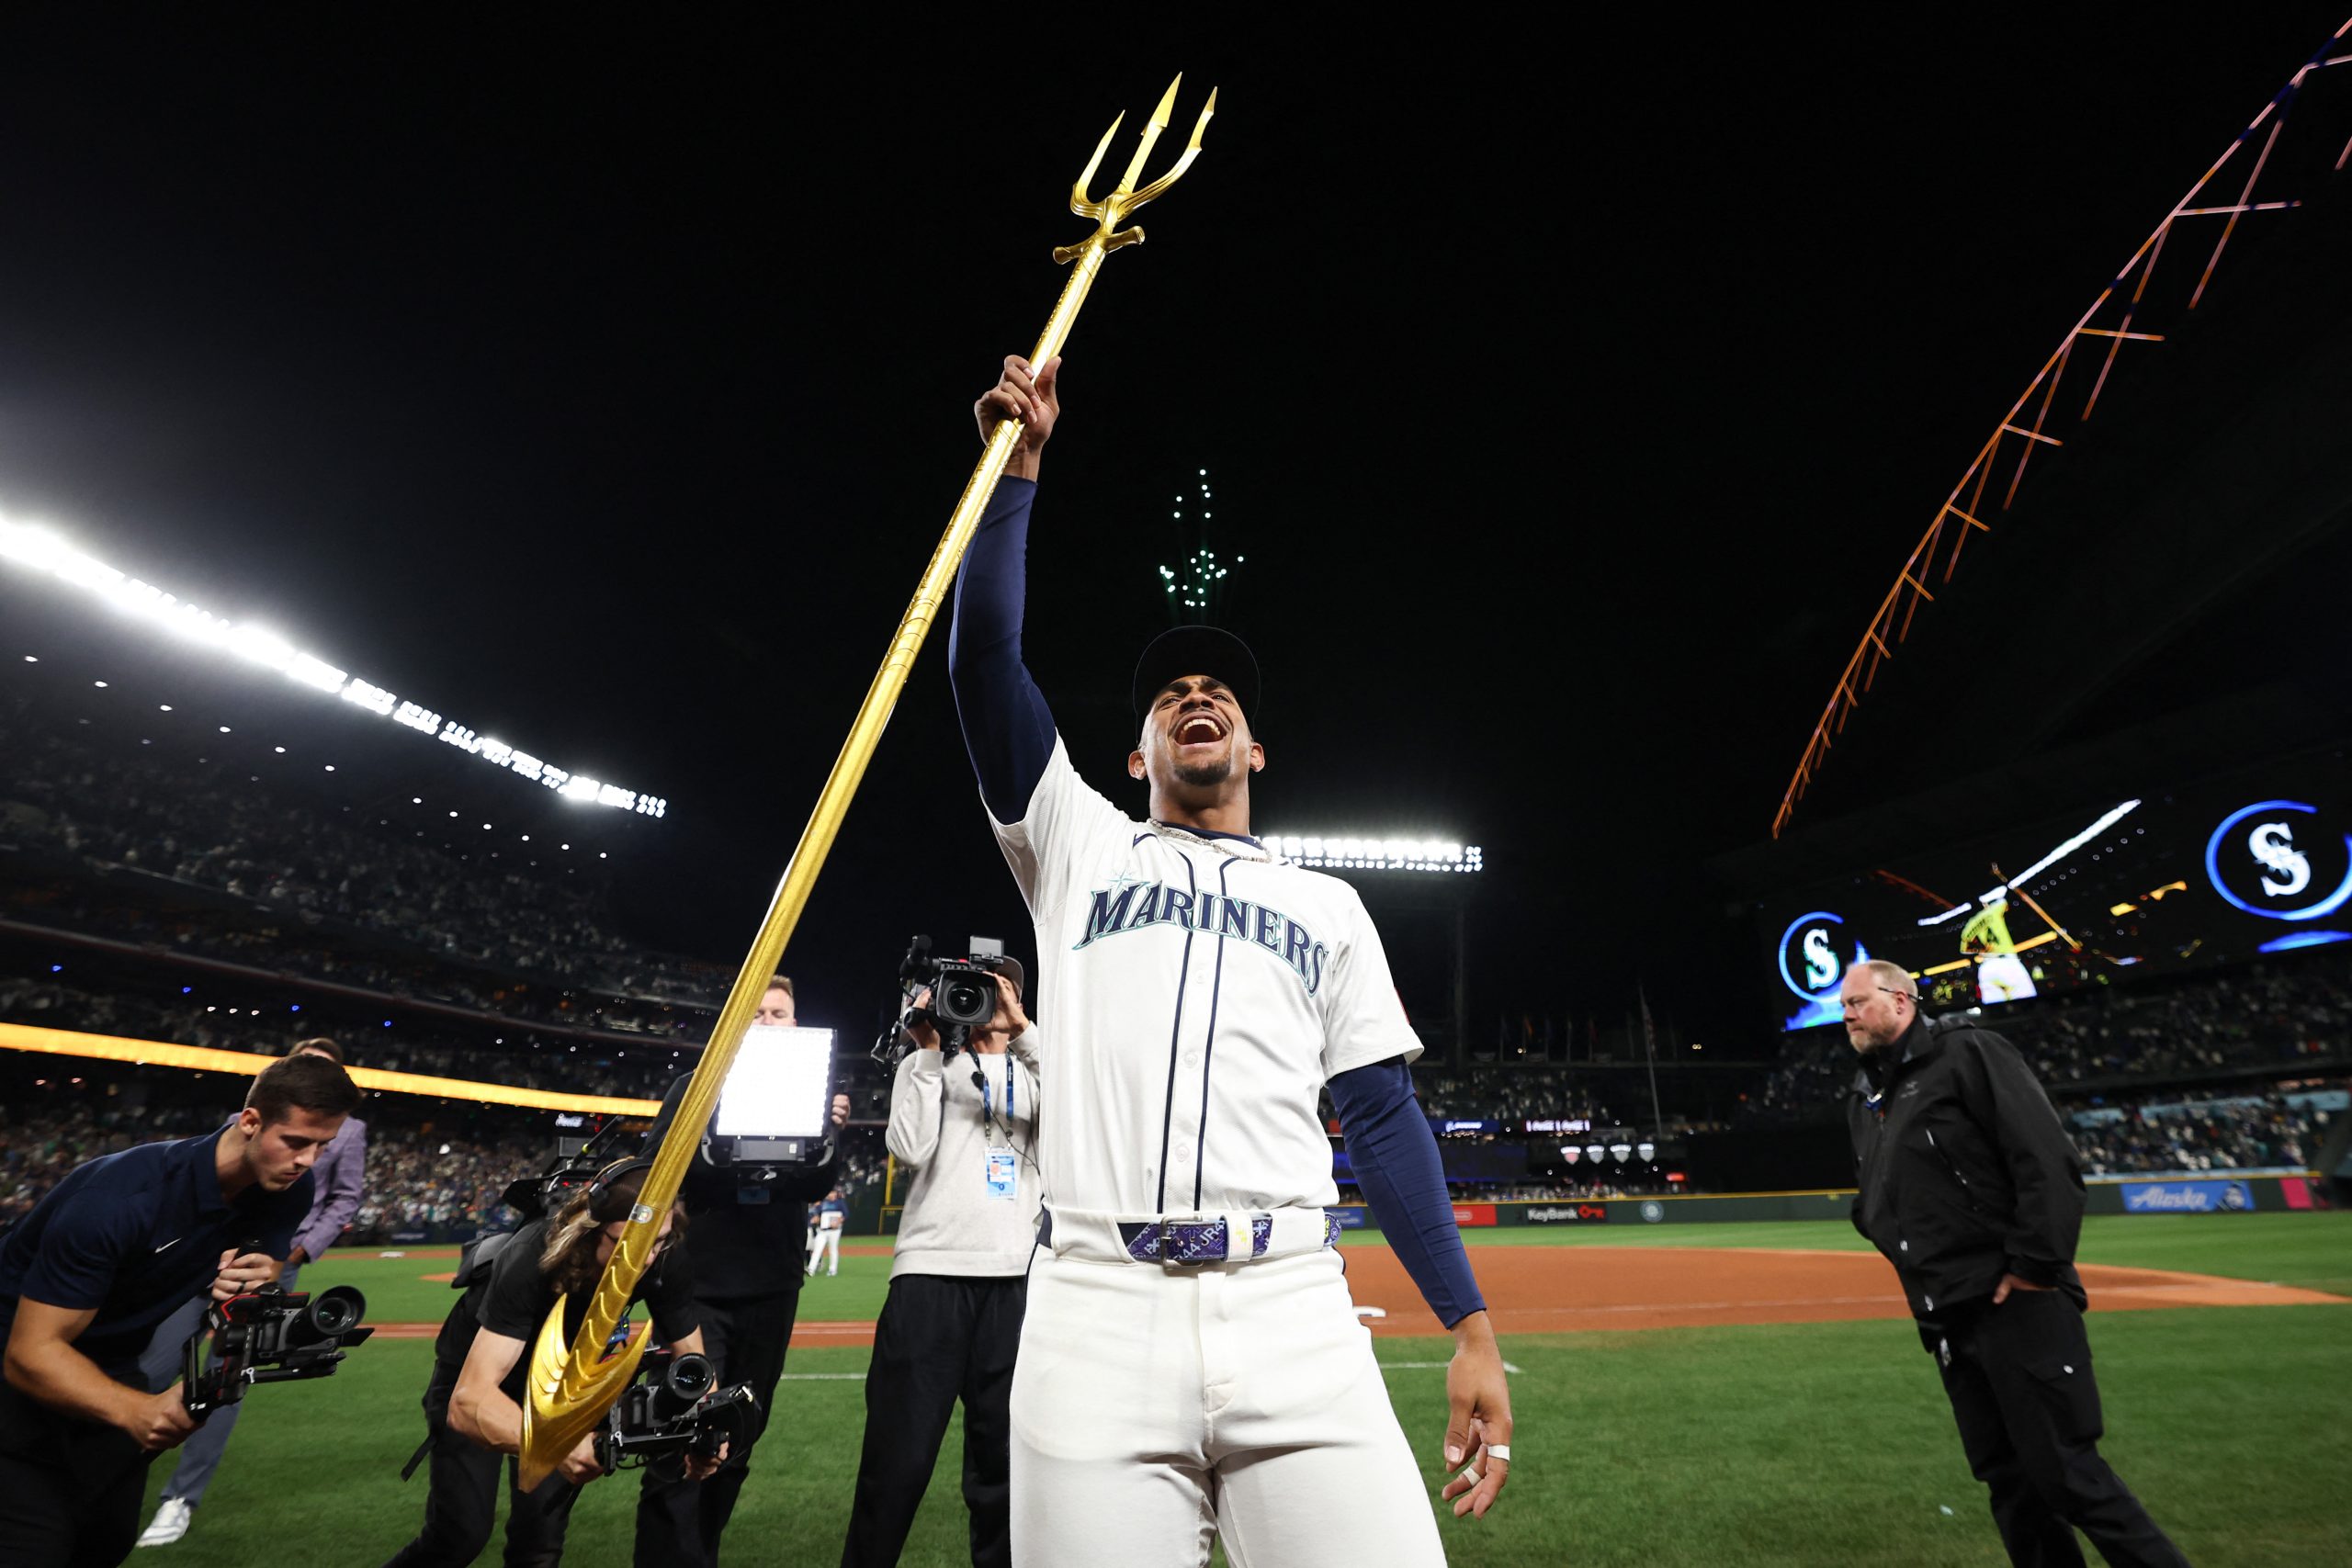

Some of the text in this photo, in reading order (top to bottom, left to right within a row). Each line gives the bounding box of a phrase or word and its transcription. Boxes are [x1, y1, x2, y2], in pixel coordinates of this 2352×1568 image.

[2249, 822, 2311, 897] S
[1072, 880, 1329, 998] MARINERS
[1803, 928, 1839, 989] S
[1527, 1207, 1578, 1223] KeyBank
[2130, 1186, 2208, 1209] Alaska
